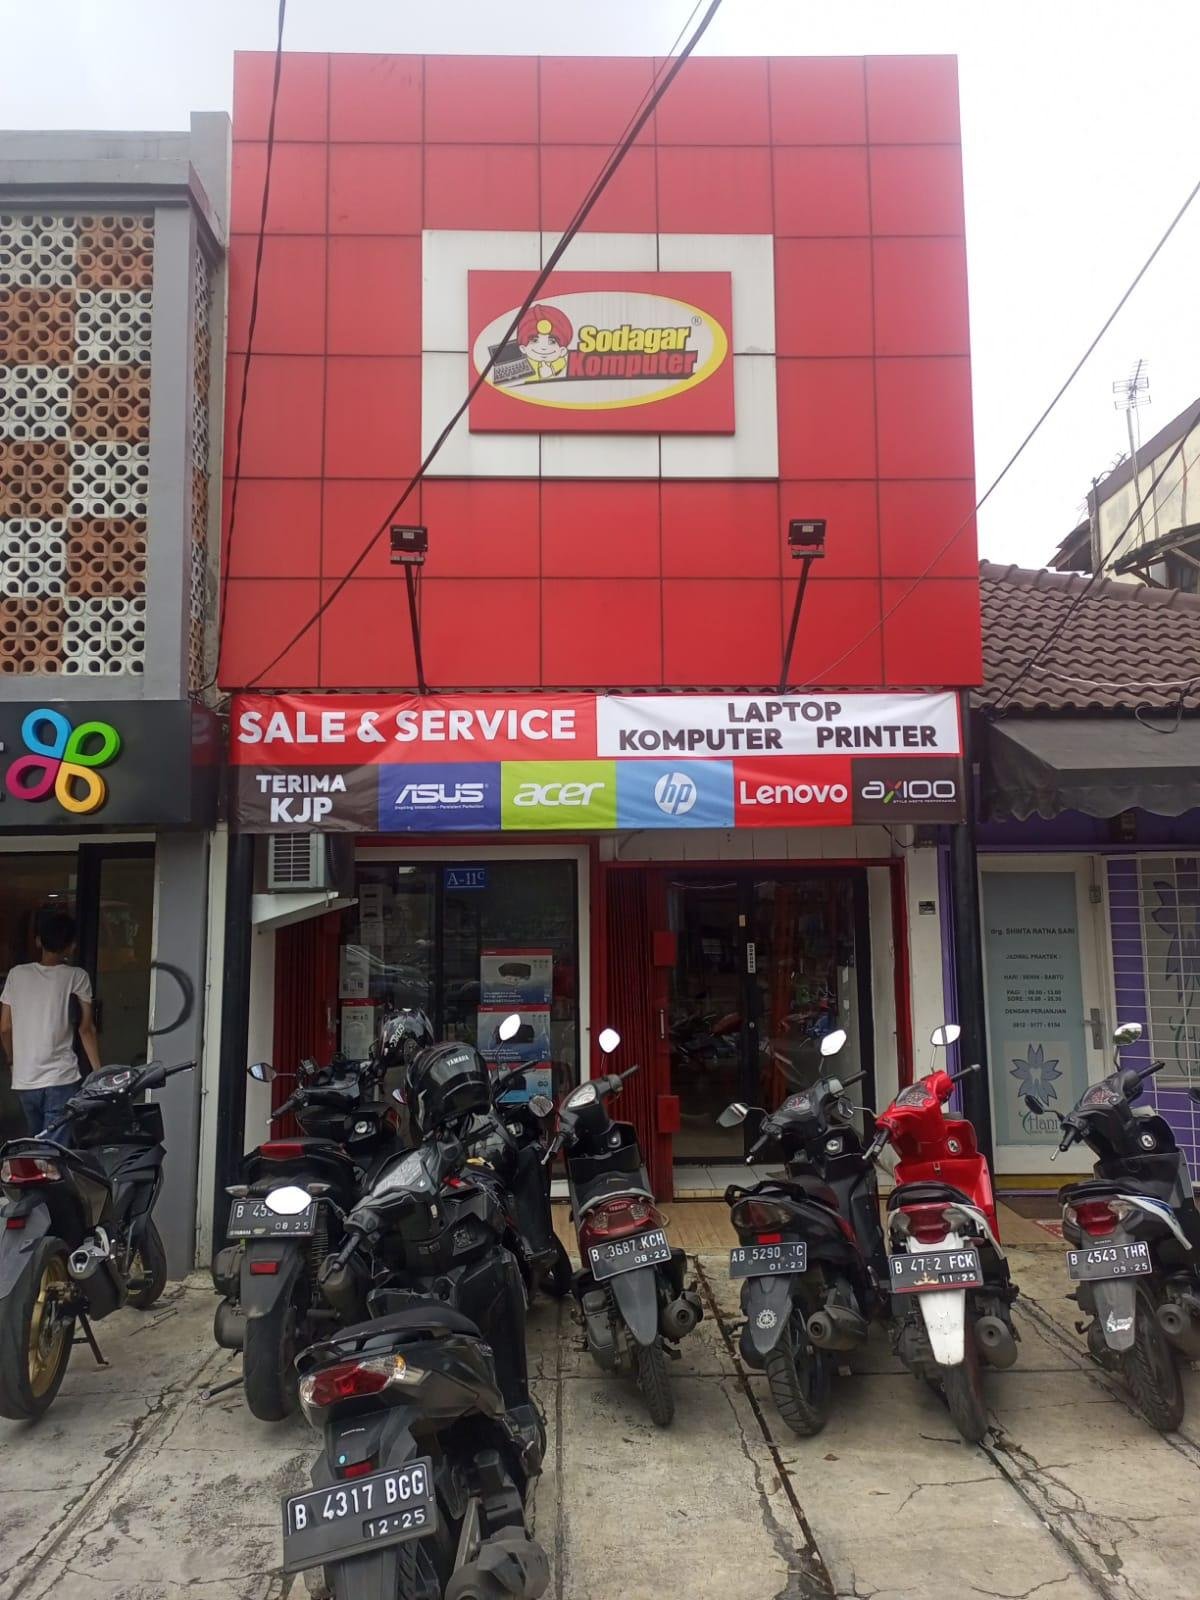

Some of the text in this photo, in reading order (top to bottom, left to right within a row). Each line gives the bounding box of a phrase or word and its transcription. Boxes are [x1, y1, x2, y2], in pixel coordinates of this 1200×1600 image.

[577, 324, 691, 354] Sodagar
[566, 350, 698, 378] Komputer
[728, 701, 842, 723] LAPTOP
[238, 708, 577, 744] SALE & SERVICE
[619, 725, 938, 751] KOMPUTER PRINTER
[255, 774, 347, 794] TERIMA
[395, 783, 484, 804] ASUS
[513, 782, 604, 806] acer
[657, 772, 694, 815] hp
[740, 781, 848, 805] Lenovo
[269, 797, 333, 823] KJP
[446, 1054, 469, 1067] YAMAHA
[236, 1205, 244, 1218] B
[591, 1232, 665, 1262] B 3687 KCH
[731, 1250, 745, 1262] AB
[752, 1246, 780, 1260] 5290
[1070, 1244, 1147, 1265] B 4543 THR
[894, 1261, 902, 1274] B
[949, 1253, 974, 1269] FCK
[294, 1470, 424, 1530] B 4317 BGG
